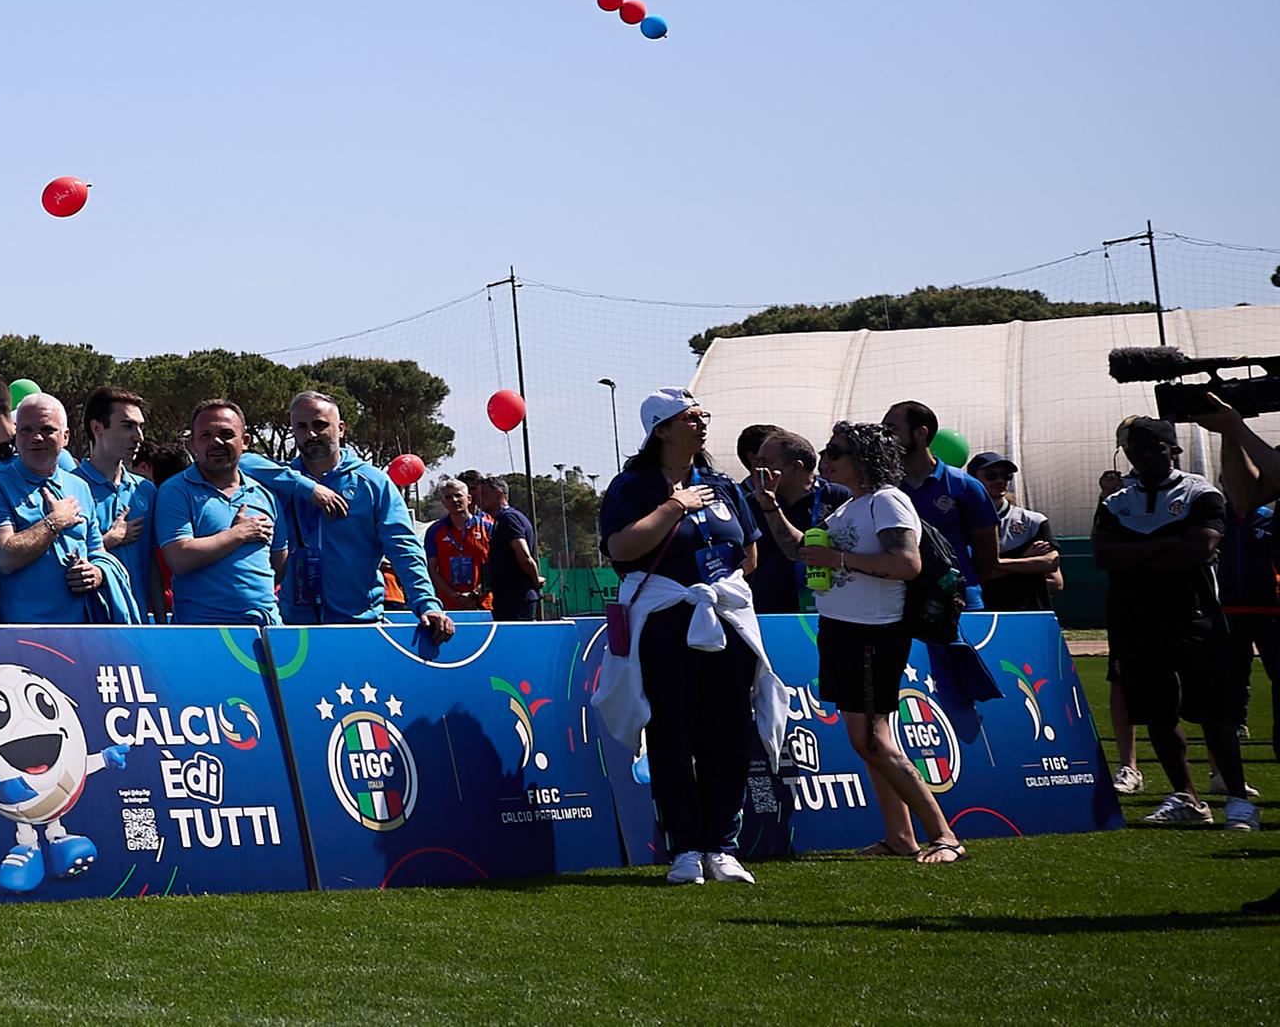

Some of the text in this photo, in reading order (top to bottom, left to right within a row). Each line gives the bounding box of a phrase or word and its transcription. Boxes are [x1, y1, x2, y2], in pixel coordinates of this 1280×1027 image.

[96, 665, 157, 703] #IL
[903, 724, 941, 748] FIGC
[348, 752, 394, 779] FIGC
[1042, 757, 1069, 771] FIGC
[527, 788, 560, 804] FIGC
[782, 773, 867, 810] TUTTI
[169, 806, 281, 848] TUTTI
[501, 811, 533, 823] CALCIO
